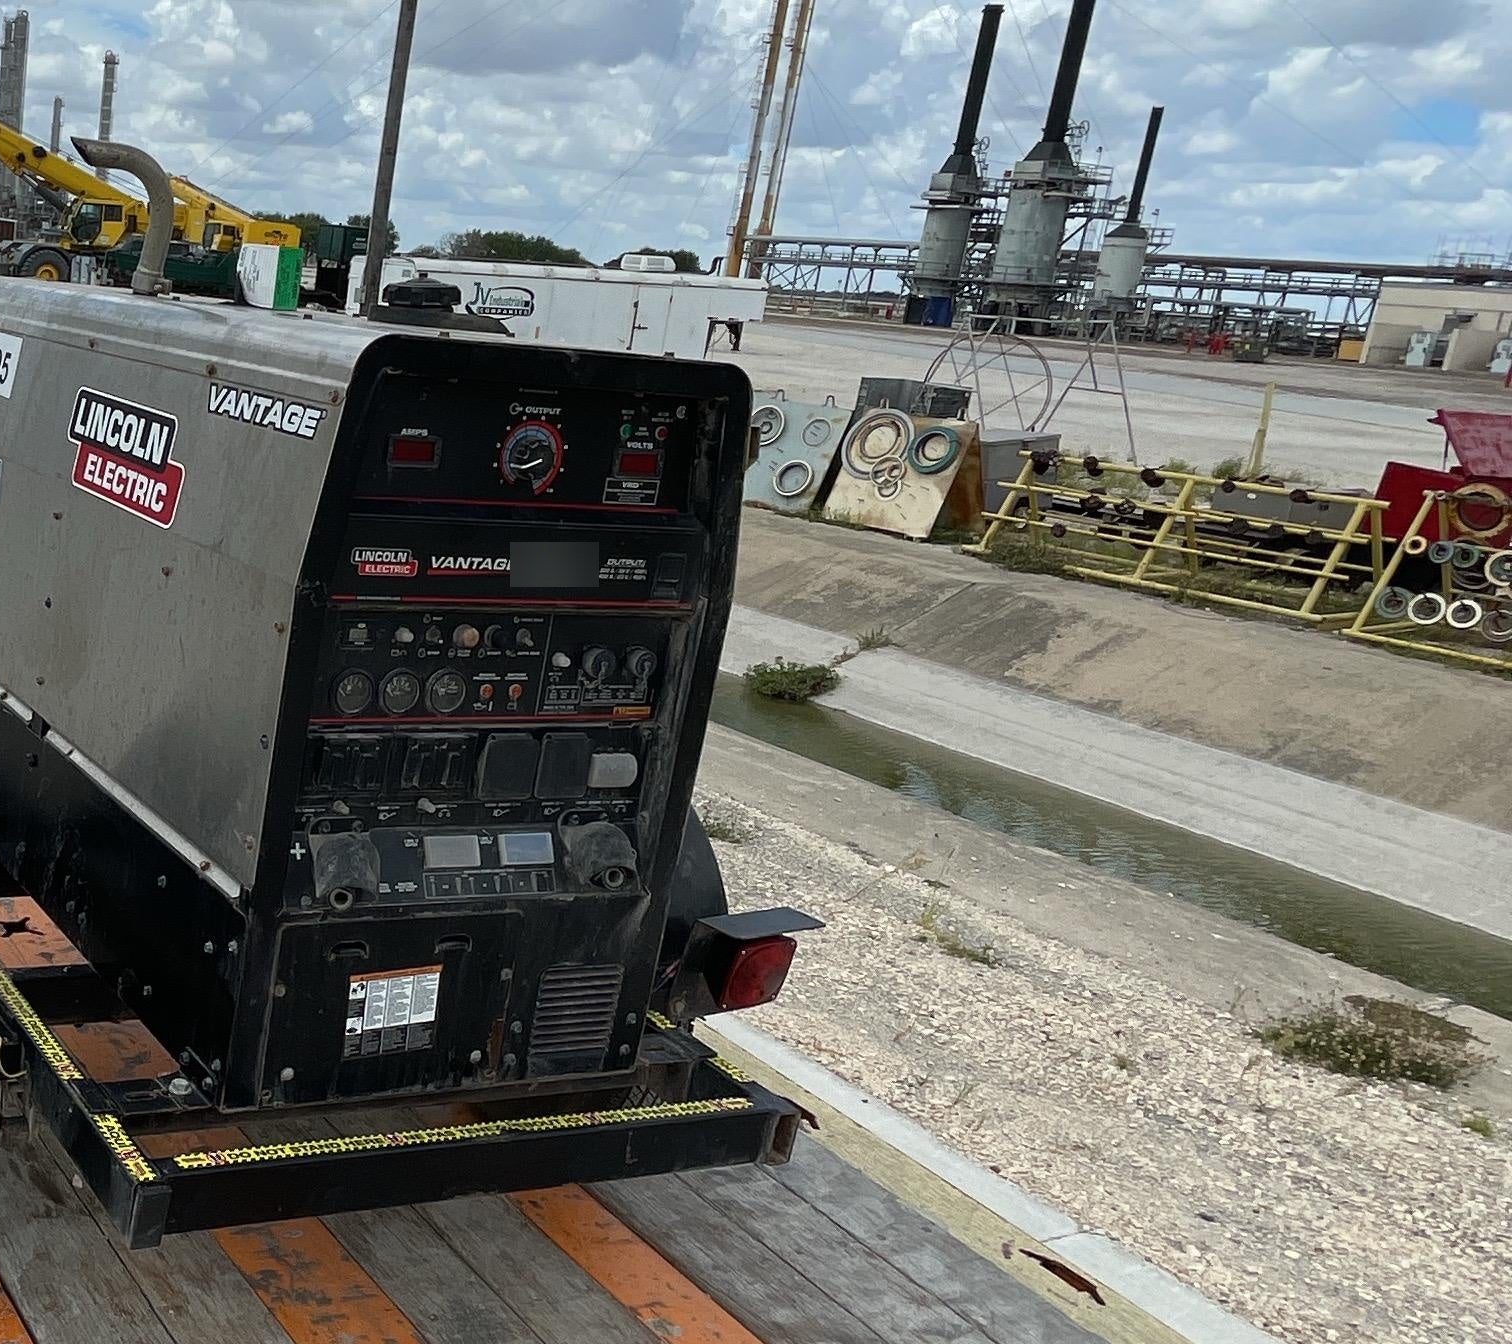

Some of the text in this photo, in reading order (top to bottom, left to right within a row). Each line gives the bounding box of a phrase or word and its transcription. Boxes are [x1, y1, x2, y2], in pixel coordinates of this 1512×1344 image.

[469, 281, 492, 306] JV
[209, 385, 322, 438] VANTAGE
[525, 406, 562, 415] OUTPUT
[73, 397, 170, 465] LINCOLN
[400, 428, 428, 436] AMPS
[626, 441, 654, 450] VOLTS
[82, 452, 168, 513] ELECTRIC
[354, 549, 408, 563] LINCOLN
[430, 556, 510, 572] VANTAG
[364, 564, 411, 574] ELECTRIC
[228, 1151, 249, 1160] DO
[254, 1146, 285, 1156] NOT
[290, 1142, 340, 1153] STAND
